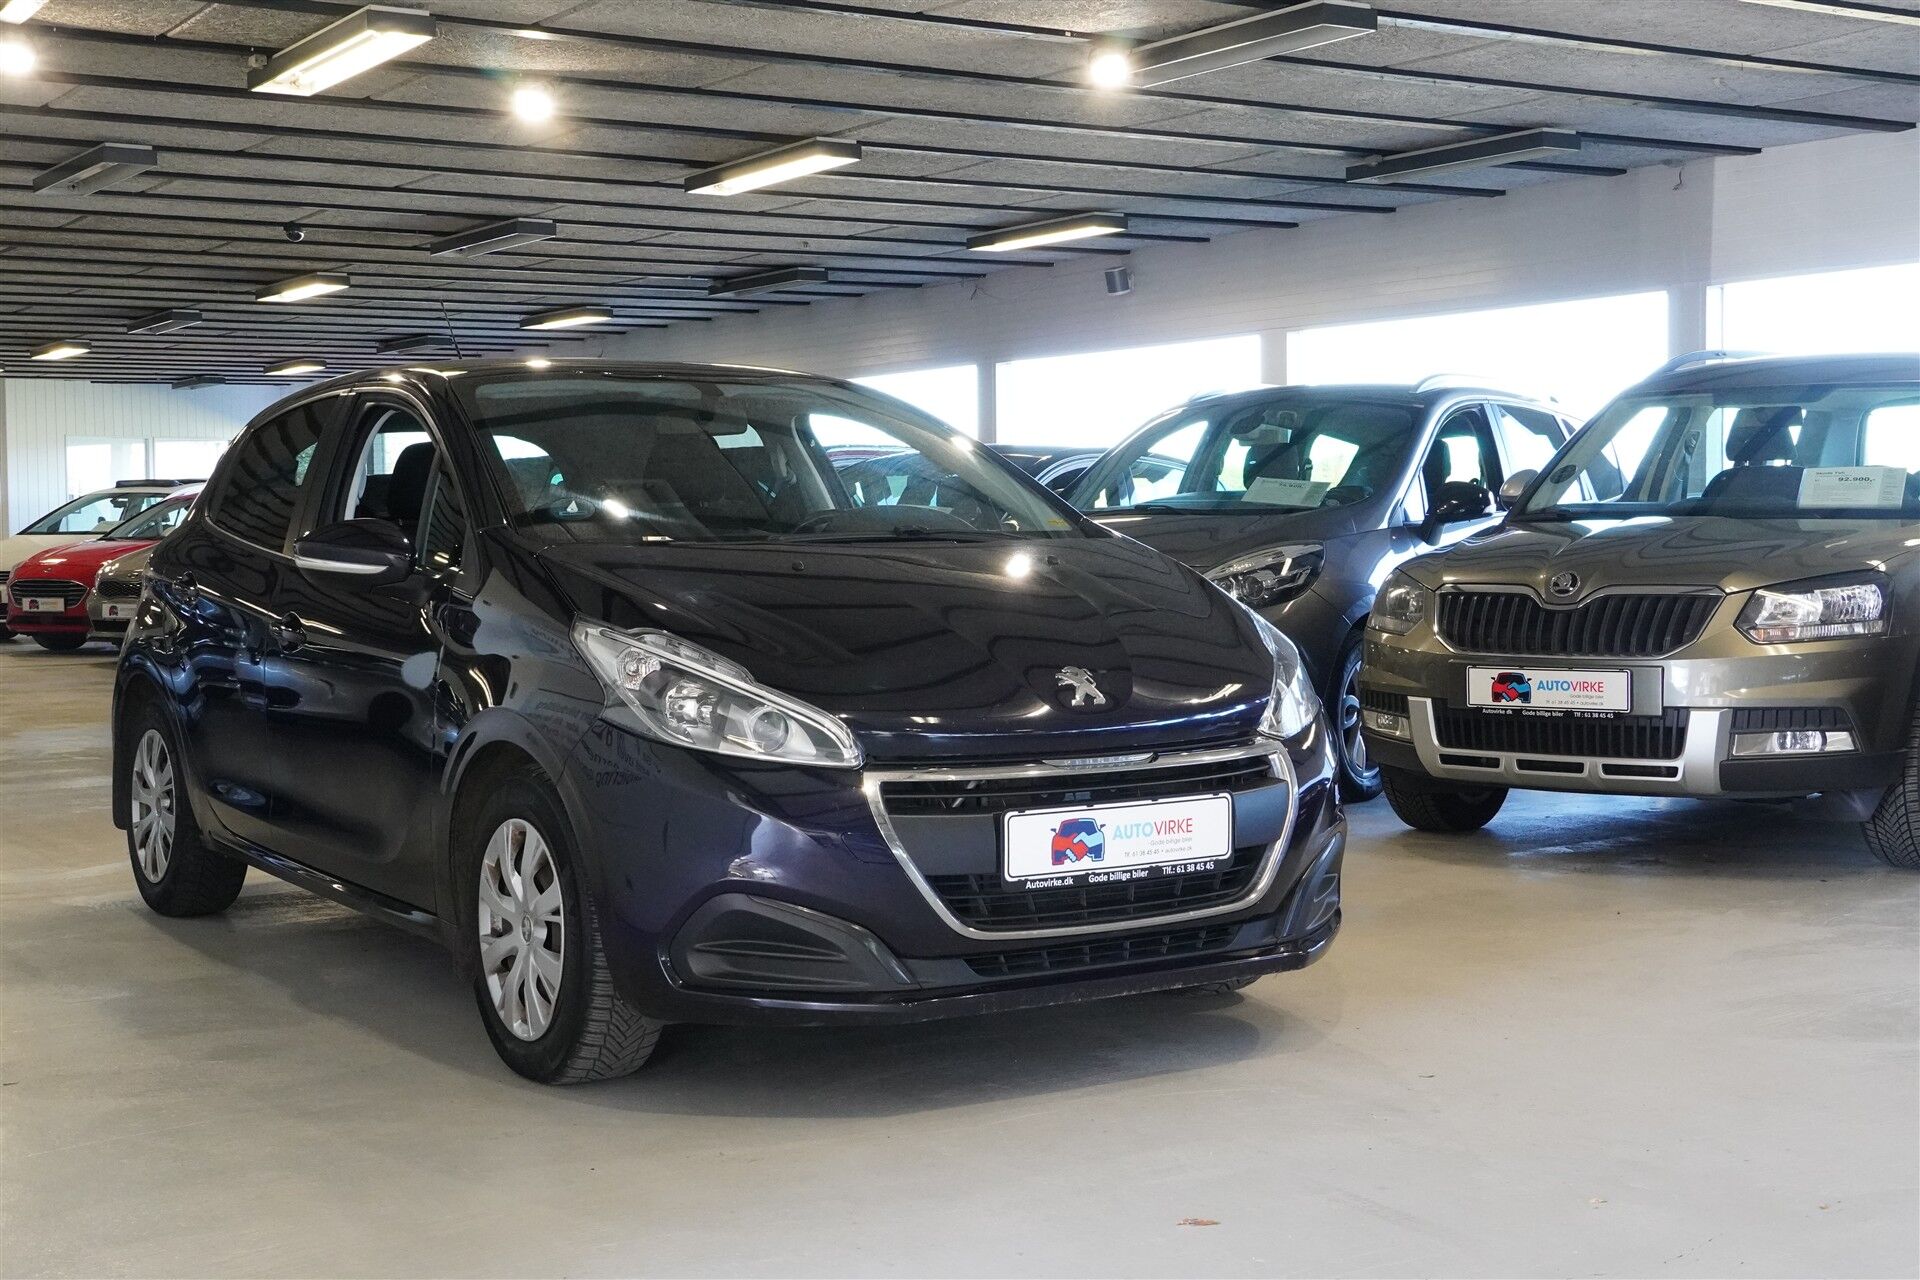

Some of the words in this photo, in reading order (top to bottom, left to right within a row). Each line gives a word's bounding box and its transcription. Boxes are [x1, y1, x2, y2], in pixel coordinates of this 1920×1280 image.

[1536, 680, 1604, 693] AUTOVIRKE
[1112, 818, 1193, 840] AUTOVIRKE
[1026, 878, 1074, 889] Autovirke.dk
[1088, 873, 1108, 883] Gode
[1109, 871, 1131, 882] billige
[1132, 869, 1149, 879] biler
[1176, 864, 1186, 873] 61
[1186, 863, 1195, 872] 38
[1195, 863, 1205, 871] 45
[1205, 861, 1215, 870] 45
